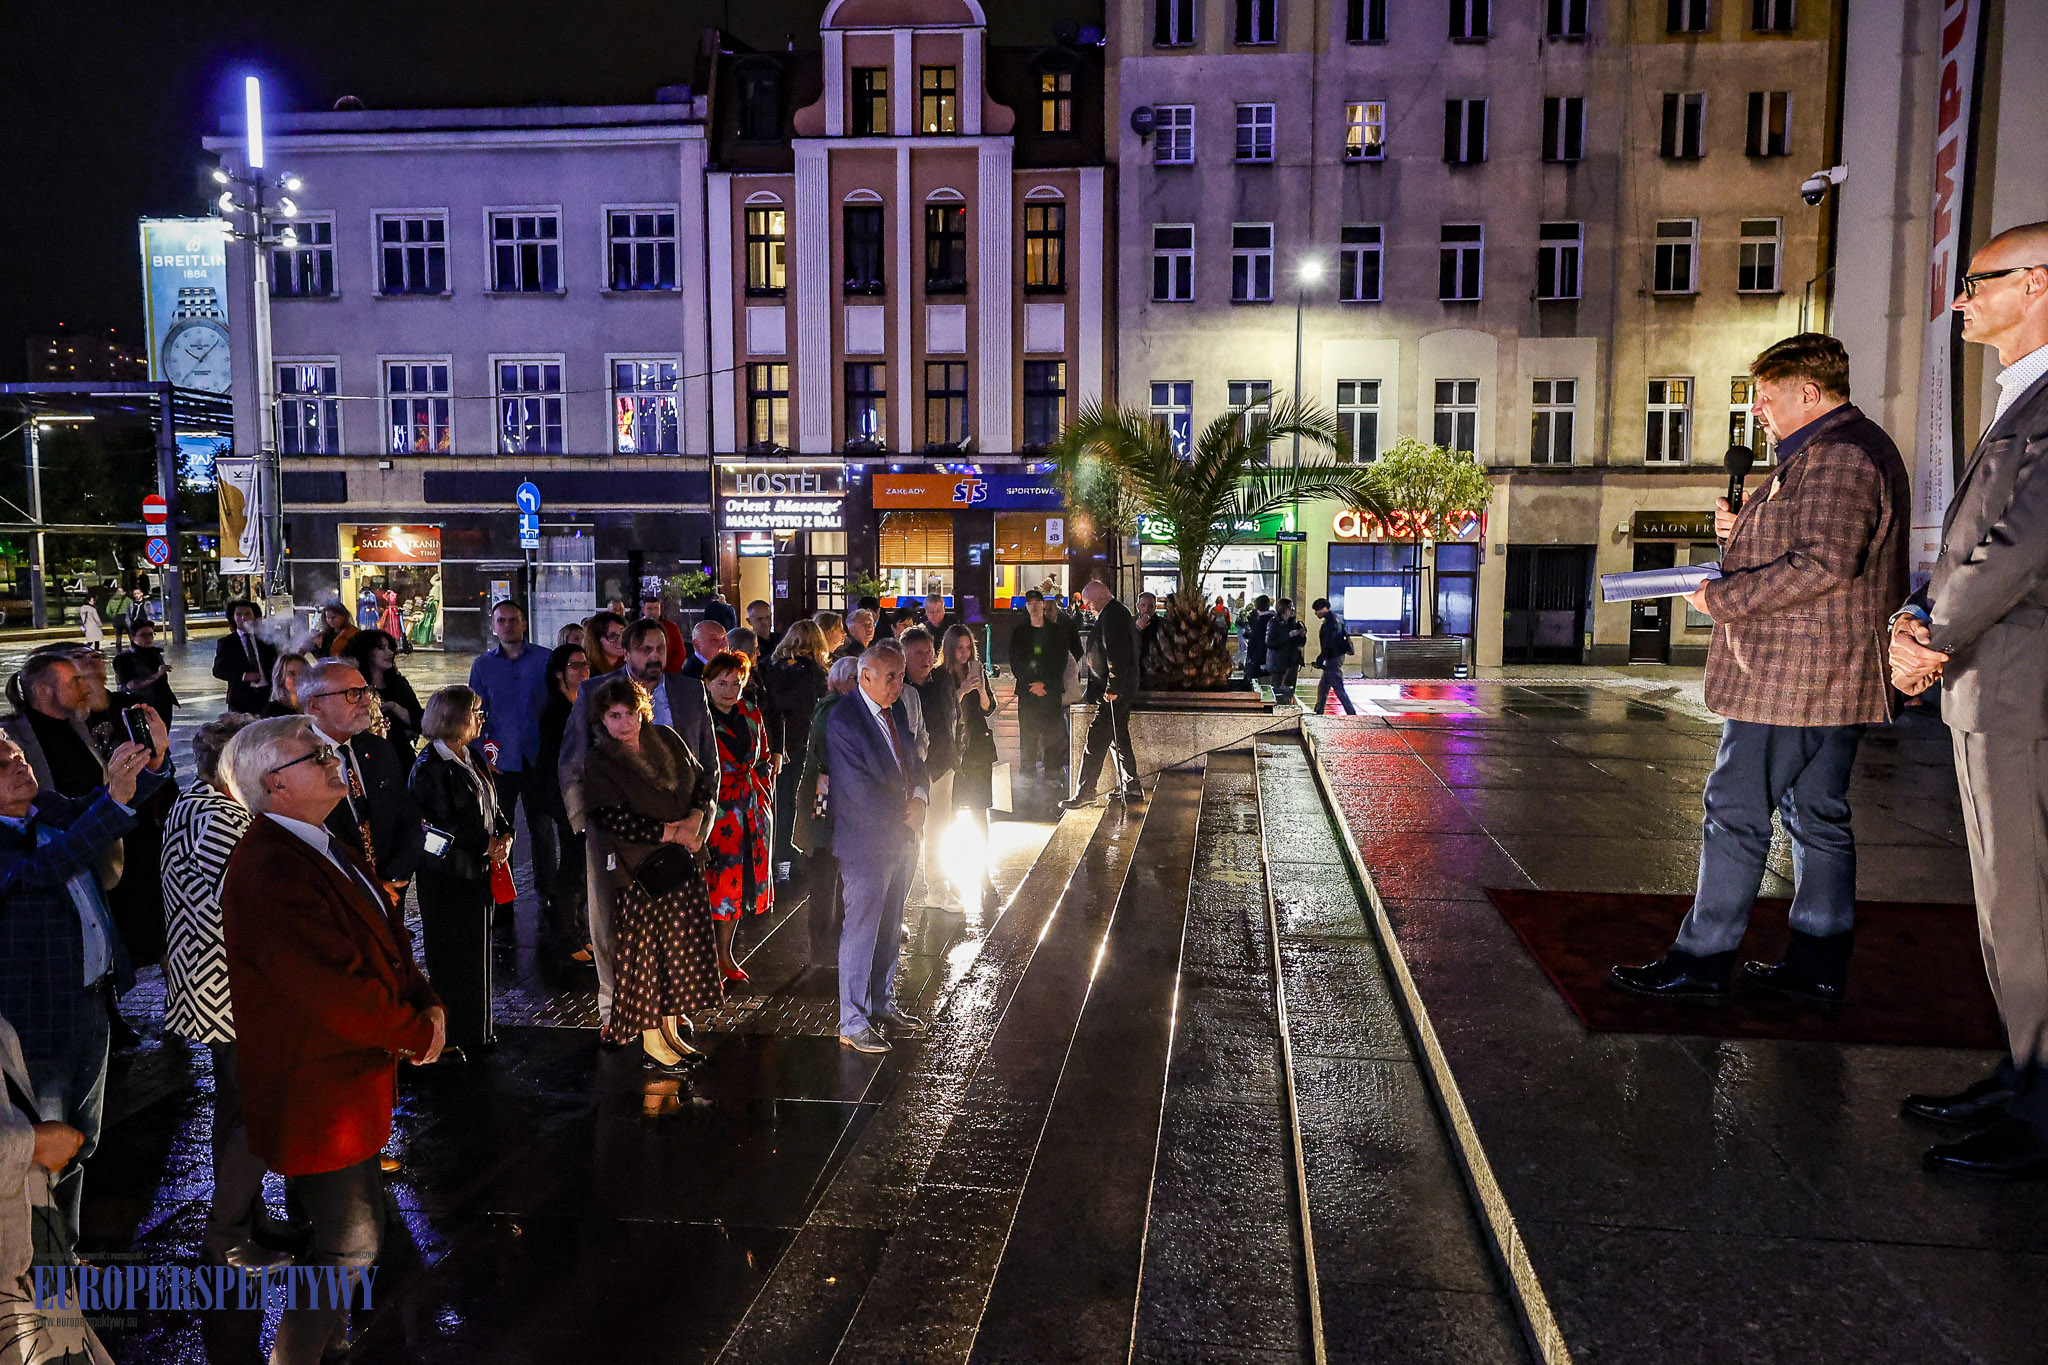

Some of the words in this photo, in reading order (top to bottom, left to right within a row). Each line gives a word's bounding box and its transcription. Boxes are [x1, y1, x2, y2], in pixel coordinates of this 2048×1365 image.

[183, 269, 207, 279] 1884
[736, 473, 829, 495] HOSTEL
[953, 479, 988, 503] STS
[1006, 487, 1055, 495] SPORTOWE
[725, 499, 771, 513] Orient
[774, 499, 839, 515] Massage
[725, 513, 802, 527] MASAŻYSTKI
[803, 516, 813, 527] Z
[814, 516, 842, 527] BALI
[1643, 524, 1688, 532] SALON
[362, 539, 393, 548] SALON
[779, 539, 790, 552] 7
